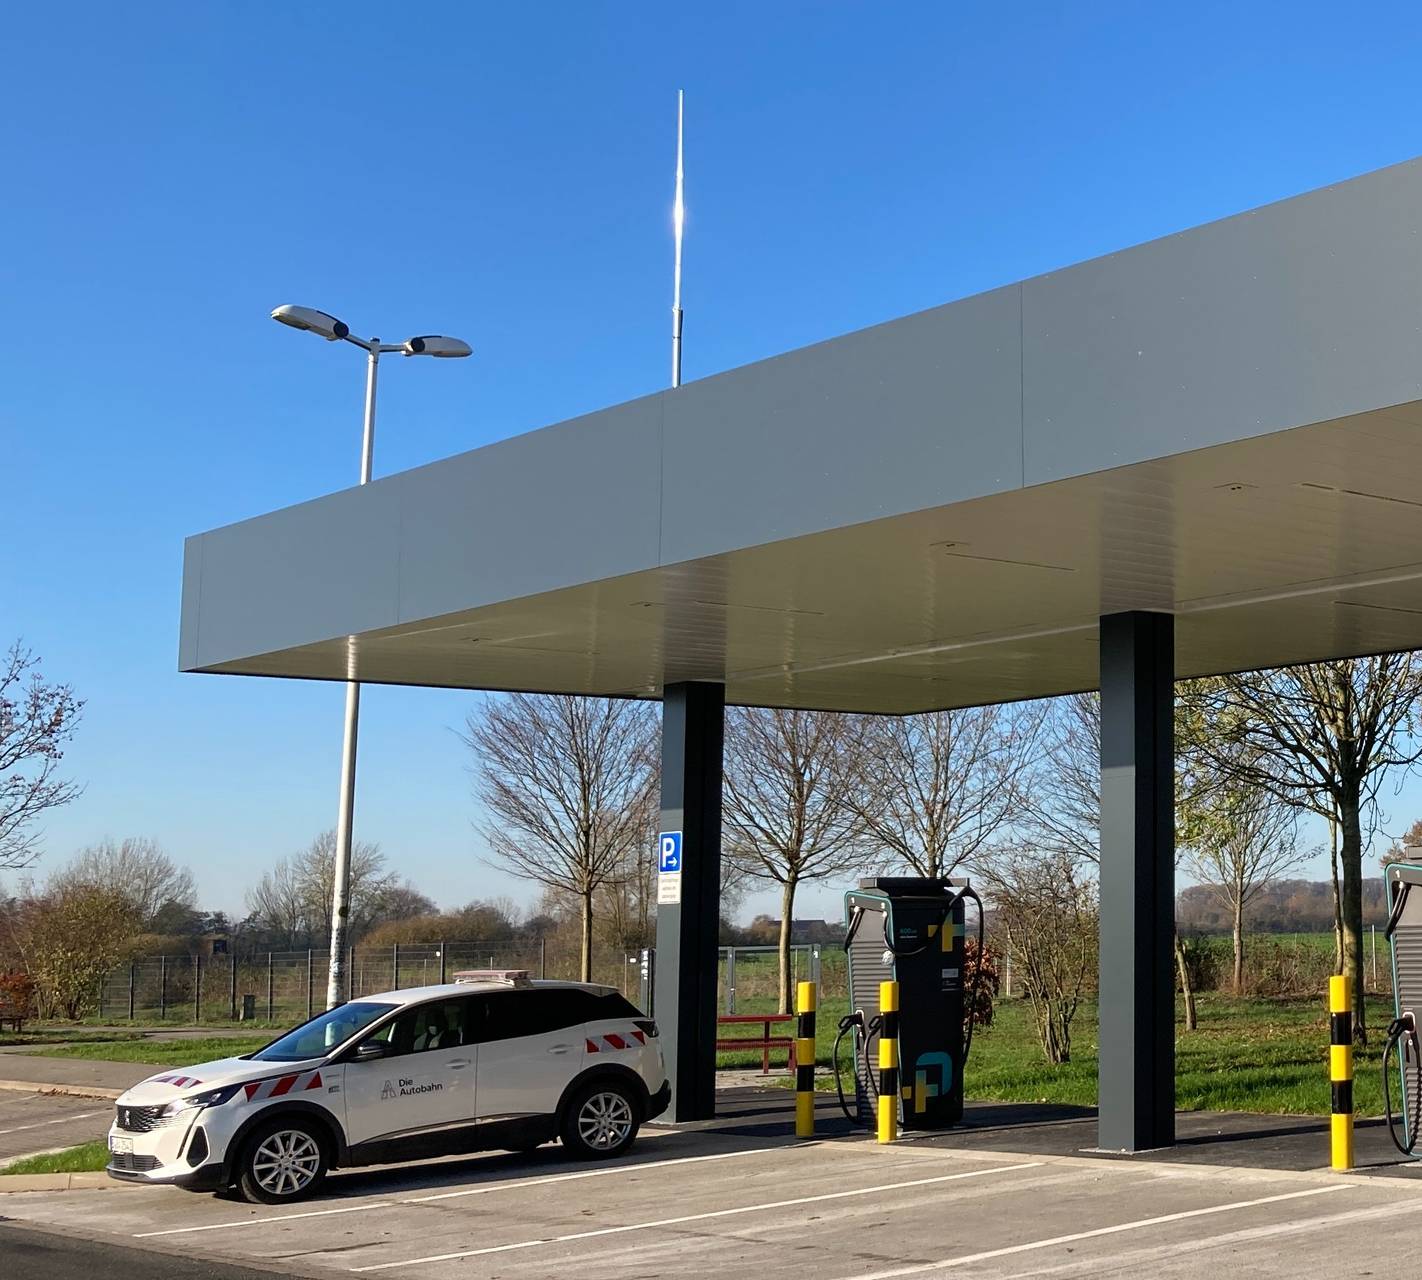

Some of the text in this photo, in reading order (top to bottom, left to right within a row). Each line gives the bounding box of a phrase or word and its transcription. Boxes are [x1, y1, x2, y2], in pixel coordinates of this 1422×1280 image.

[662, 837, 675, 868] P
[398, 1078, 413, 1088] Die
[399, 1083, 443, 1097] Autobahn
